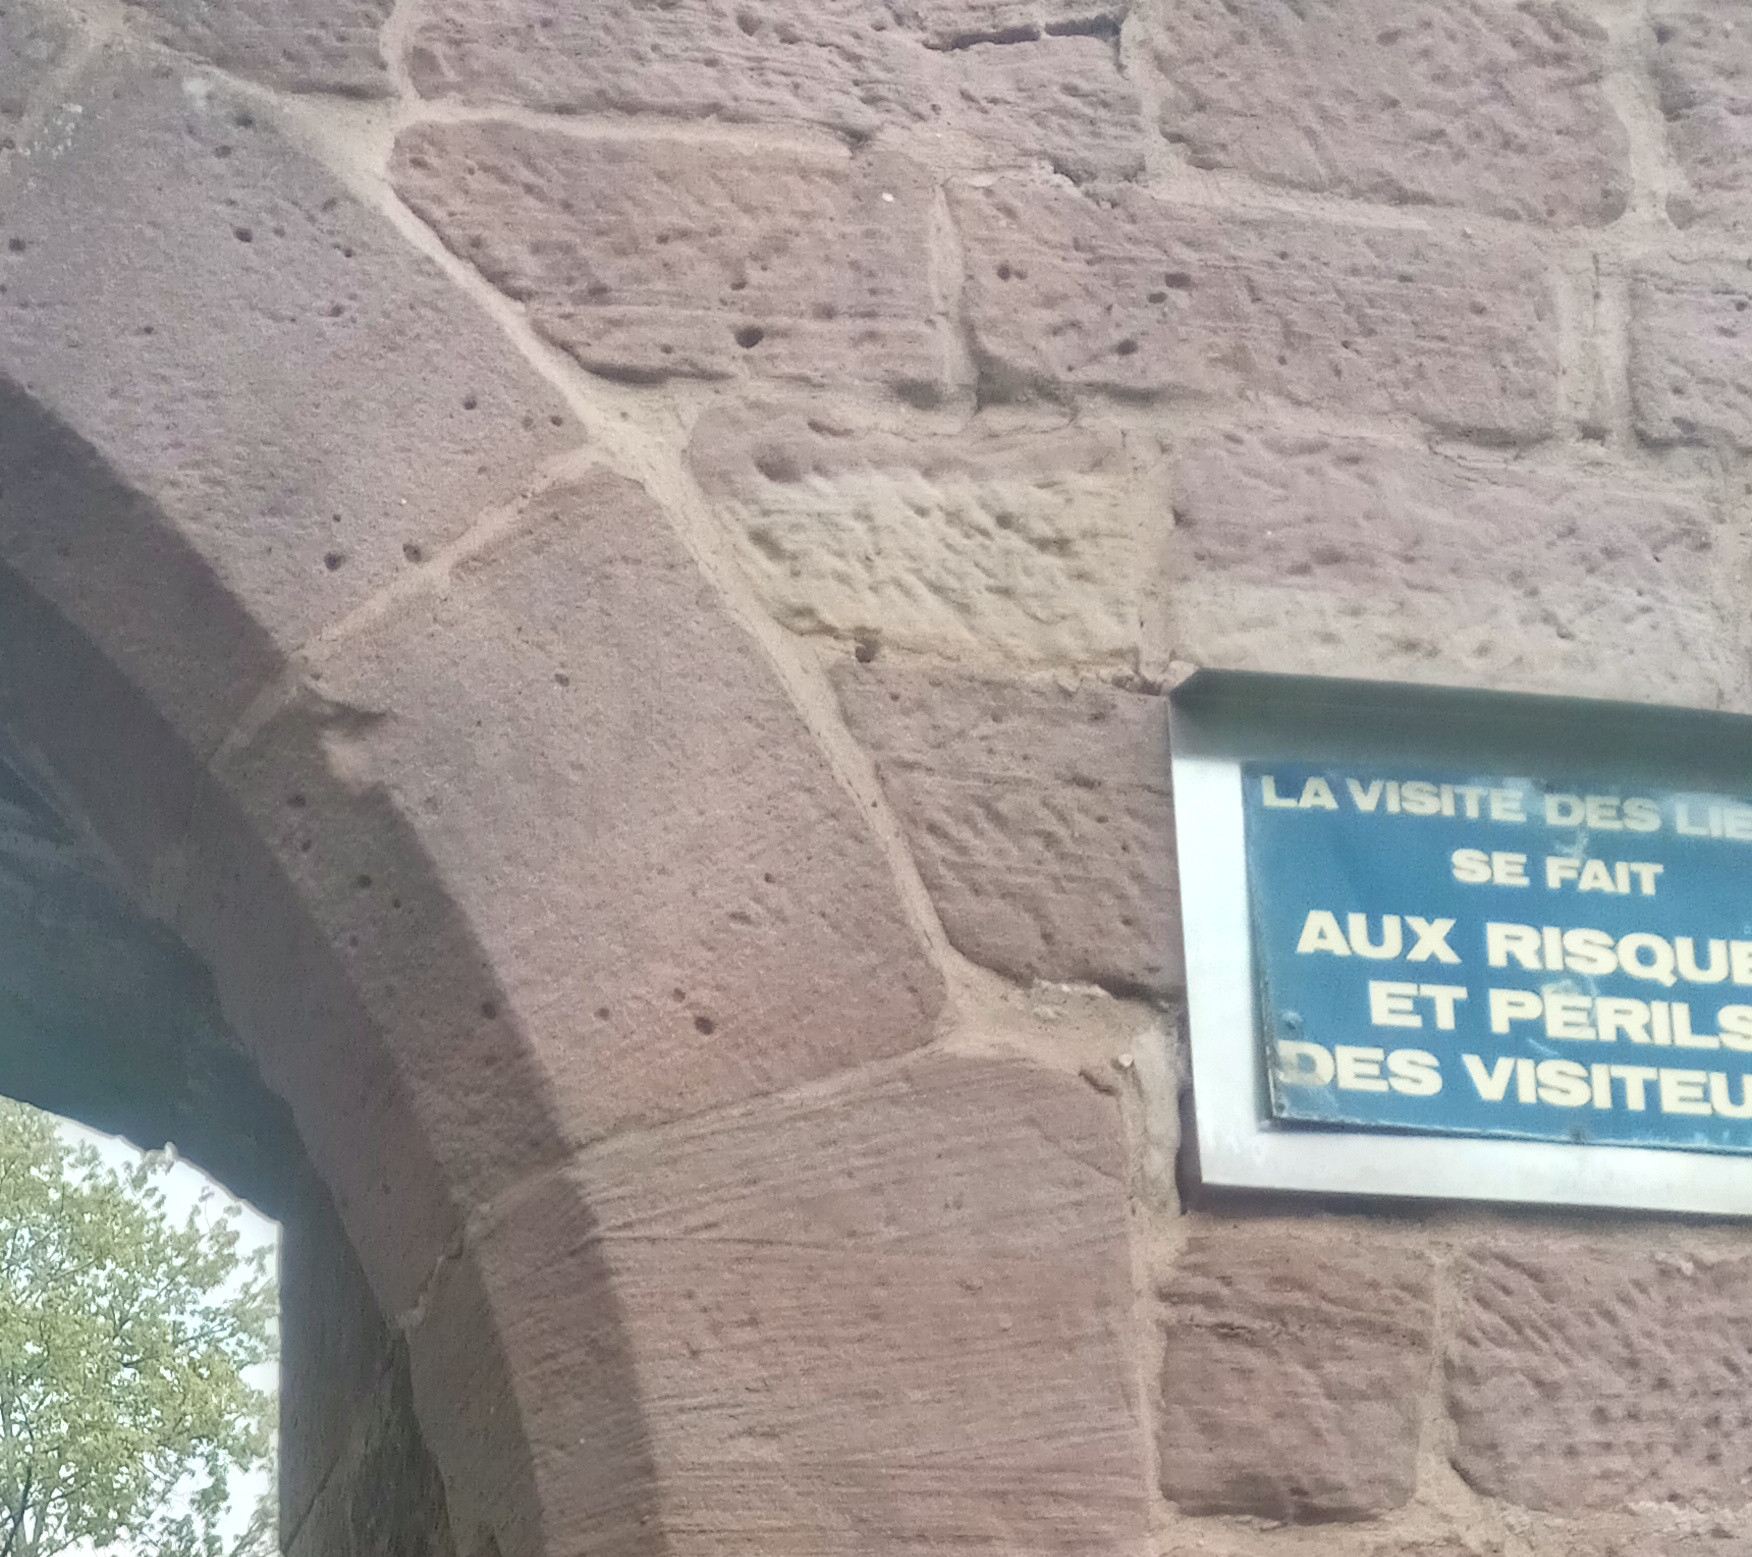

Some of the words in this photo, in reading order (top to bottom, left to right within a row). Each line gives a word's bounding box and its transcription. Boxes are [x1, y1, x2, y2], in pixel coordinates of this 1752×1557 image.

[1261, 775, 1338, 811] LA
[1347, 780, 1526, 822] VISITE
[1543, 794, 1662, 833] DES
[1451, 848, 1529, 886] SE
[1545, 855, 1664, 896] FAIT
[1295, 909, 1461, 964] AUX
[1368, 980, 1468, 1031] ET
[1276, 1040, 1443, 1096] DES
